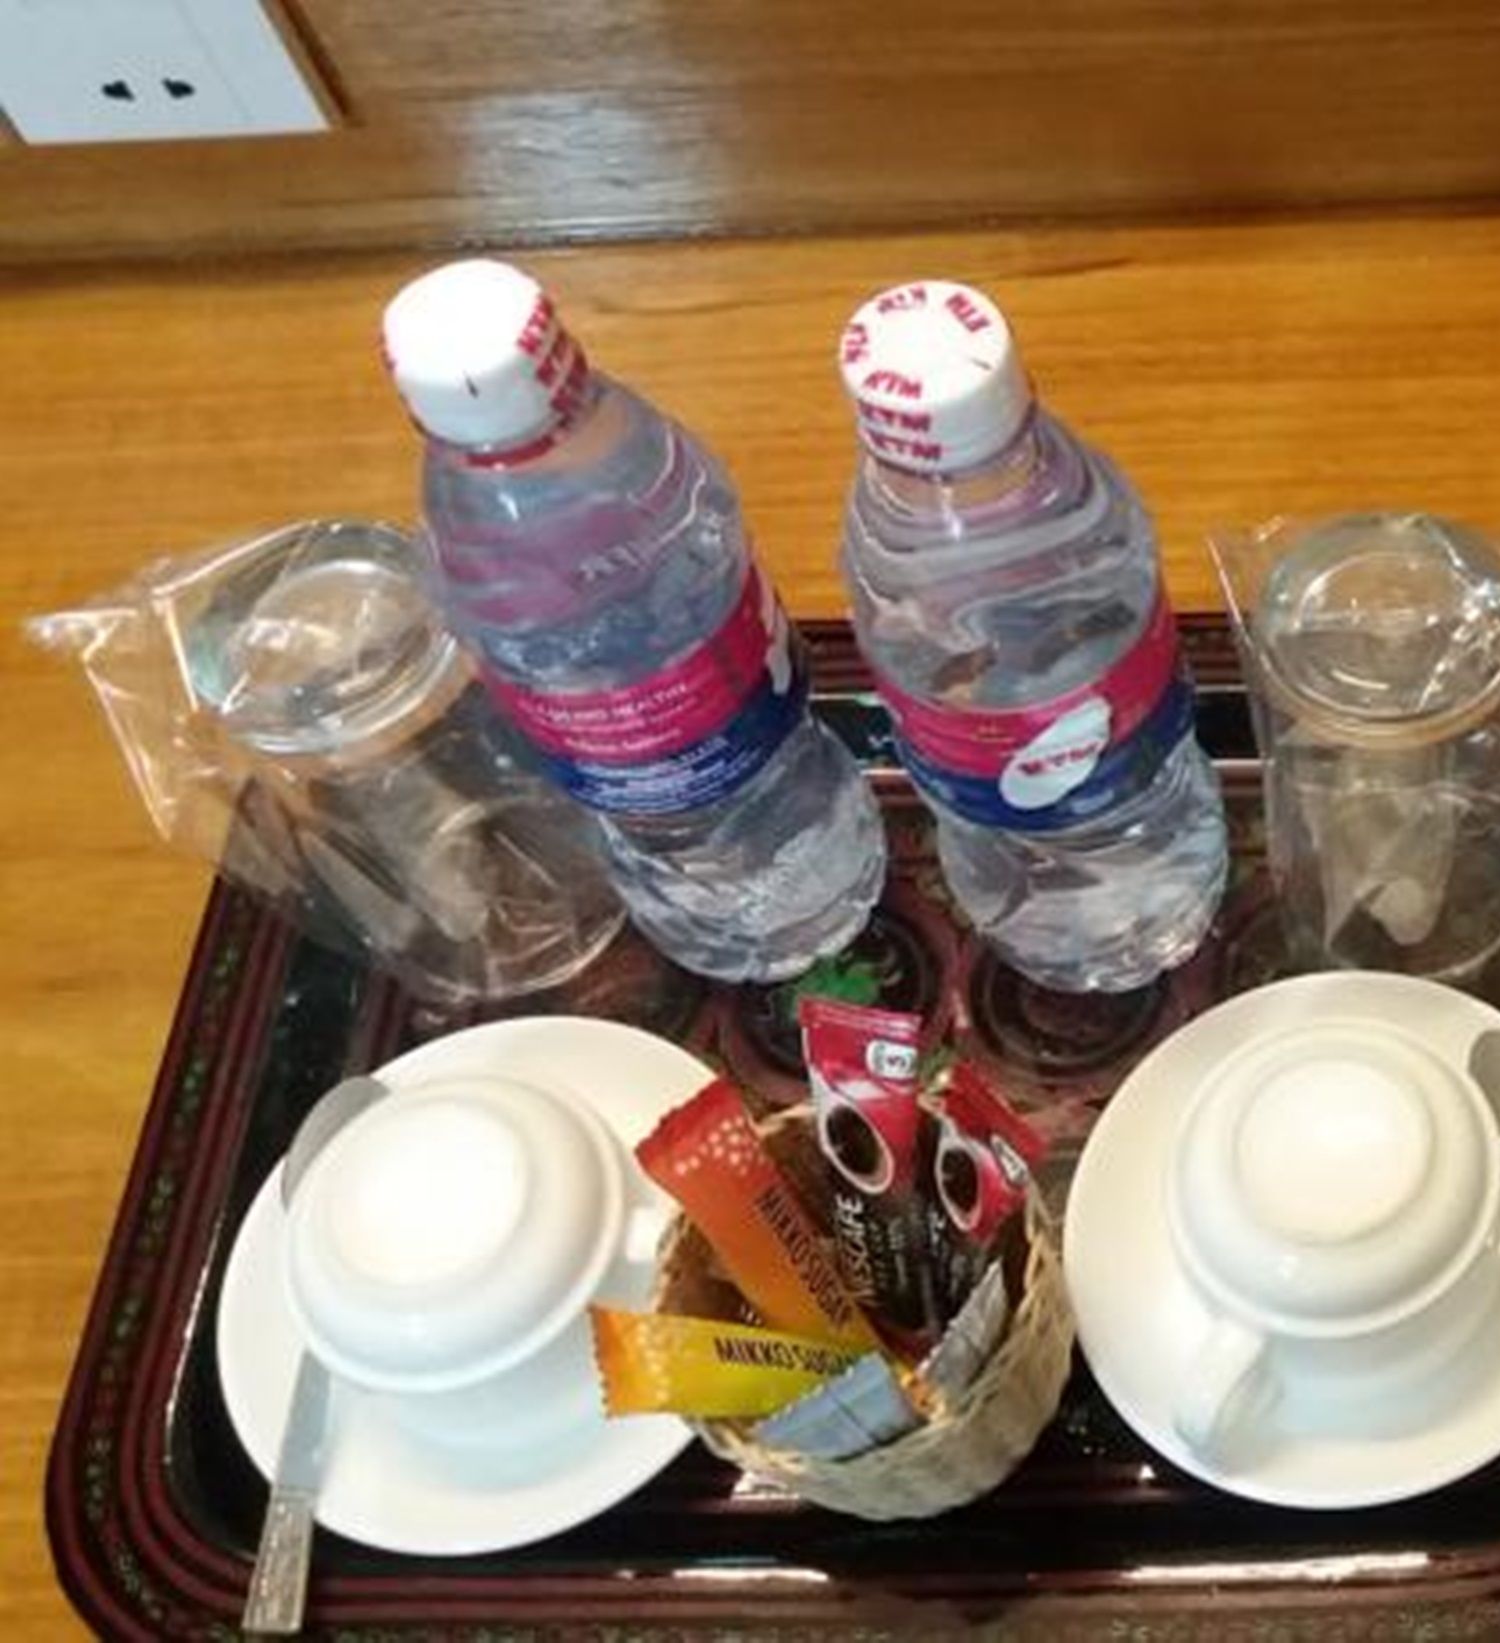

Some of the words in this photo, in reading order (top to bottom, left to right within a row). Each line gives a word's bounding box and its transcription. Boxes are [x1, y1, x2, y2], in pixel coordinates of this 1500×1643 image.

[864, 370, 922, 399] KTM
[859, 401, 931, 433] KTM
[865, 430, 942, 459] KTM
[1018, 742, 1100, 776] KTM
